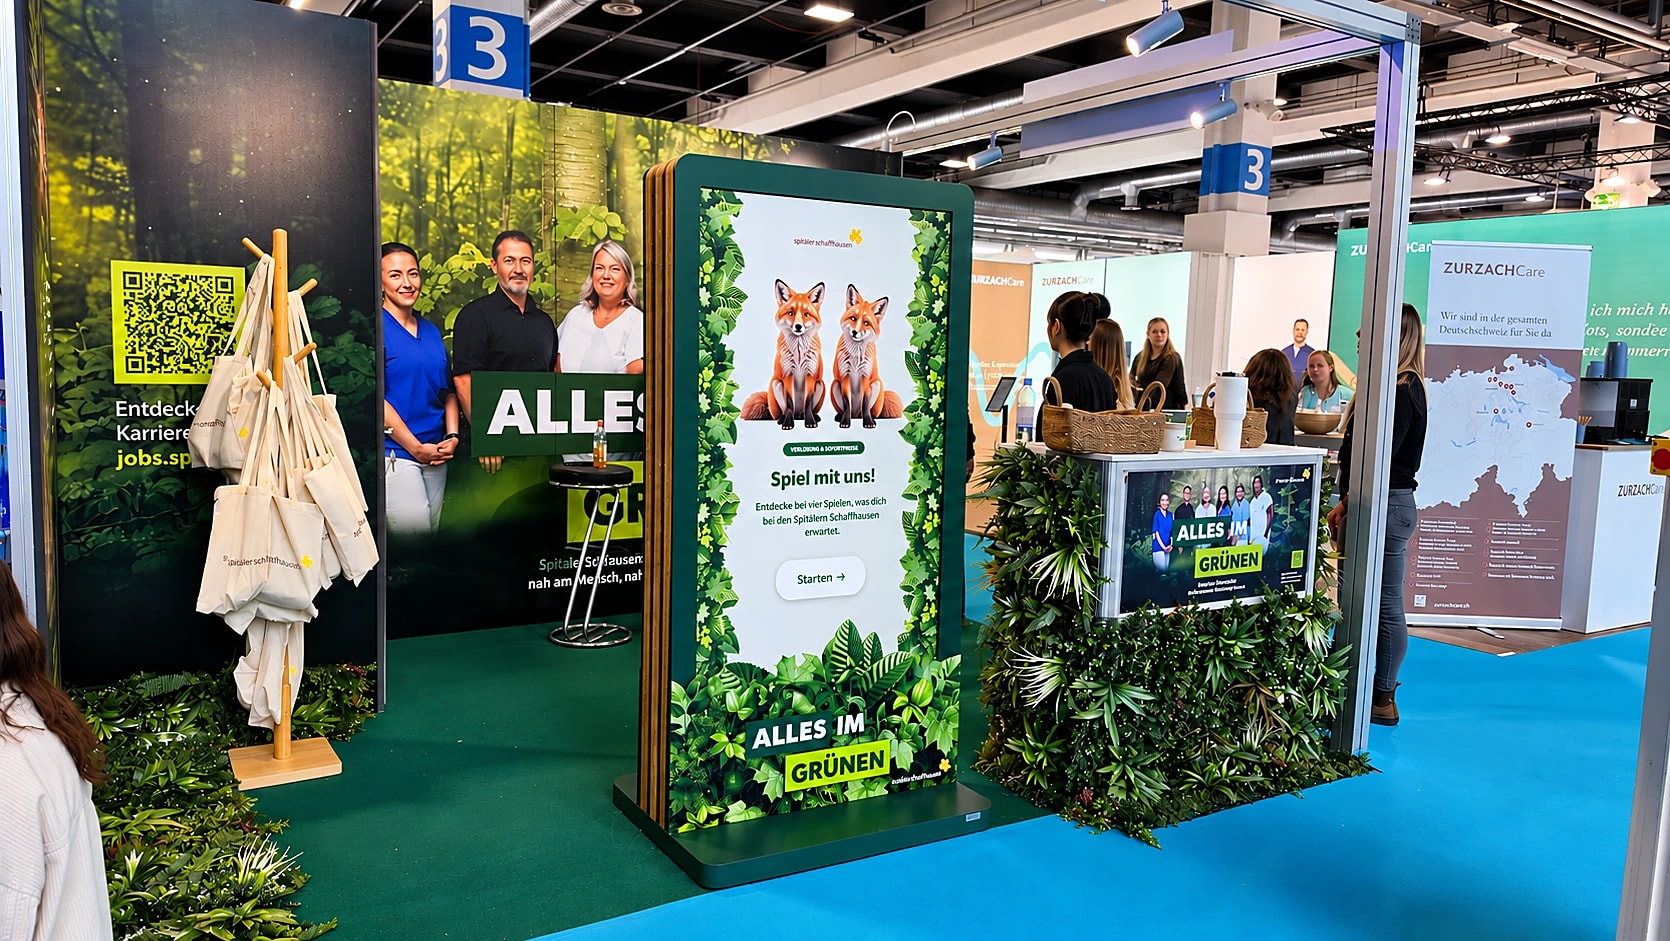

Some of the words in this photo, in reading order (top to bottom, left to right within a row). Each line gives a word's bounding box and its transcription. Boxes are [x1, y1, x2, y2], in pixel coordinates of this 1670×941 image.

[435, 18, 448, 82] 3
[467, 16, 507, 80] 3
[1244, 149, 1265, 192] 3
[1443, 261, 1546, 277] ZURZACHCare
[1042, 275, 1094, 286] ZURZACHCare
[1590, 303, 1613, 316] ich
[1616, 302, 1654, 316] mich
[1440, 311, 1458, 321] Wir
[1459, 312, 1478, 322] sind
[1480, 313, 1488, 322] in
[1490, 314, 1505, 322] der
[1506, 316, 1548, 325] gesamten
[1525, 328, 1539, 338] Sie
[1541, 329, 1552, 338] da
[487, 389, 644, 435] ALLE
[771, 470, 810, 490] Spiel
[814, 469, 840, 485] mit
[844, 468, 875, 484] uns!
[756, 502, 793, 511] Entdecke
[794, 500, 807, 509] bei
[808, 500, 822, 509] vier
[823, 499, 854, 510] Spielen,
[855, 498, 870, 506] was
[870, 497, 887, 505] dich
[762, 516, 775, 525] bei
[776, 515, 792, 524] den
[829, 511, 880, 521] Schaffhausen
[804, 528, 840, 537] erwartet.
[1176, 521, 1225, 541] ALLES
[1230, 520, 1248, 536] IM
[1199, 549, 1259, 572] GRÜNEN
[528, 577, 551, 589] nah
[553, 577, 572, 587] am
[797, 574, 833, 585] Starten
[752, 719, 827, 750] ALLES
[837, 713, 865, 736] IM
[791, 750, 885, 782] GRÜNEN
